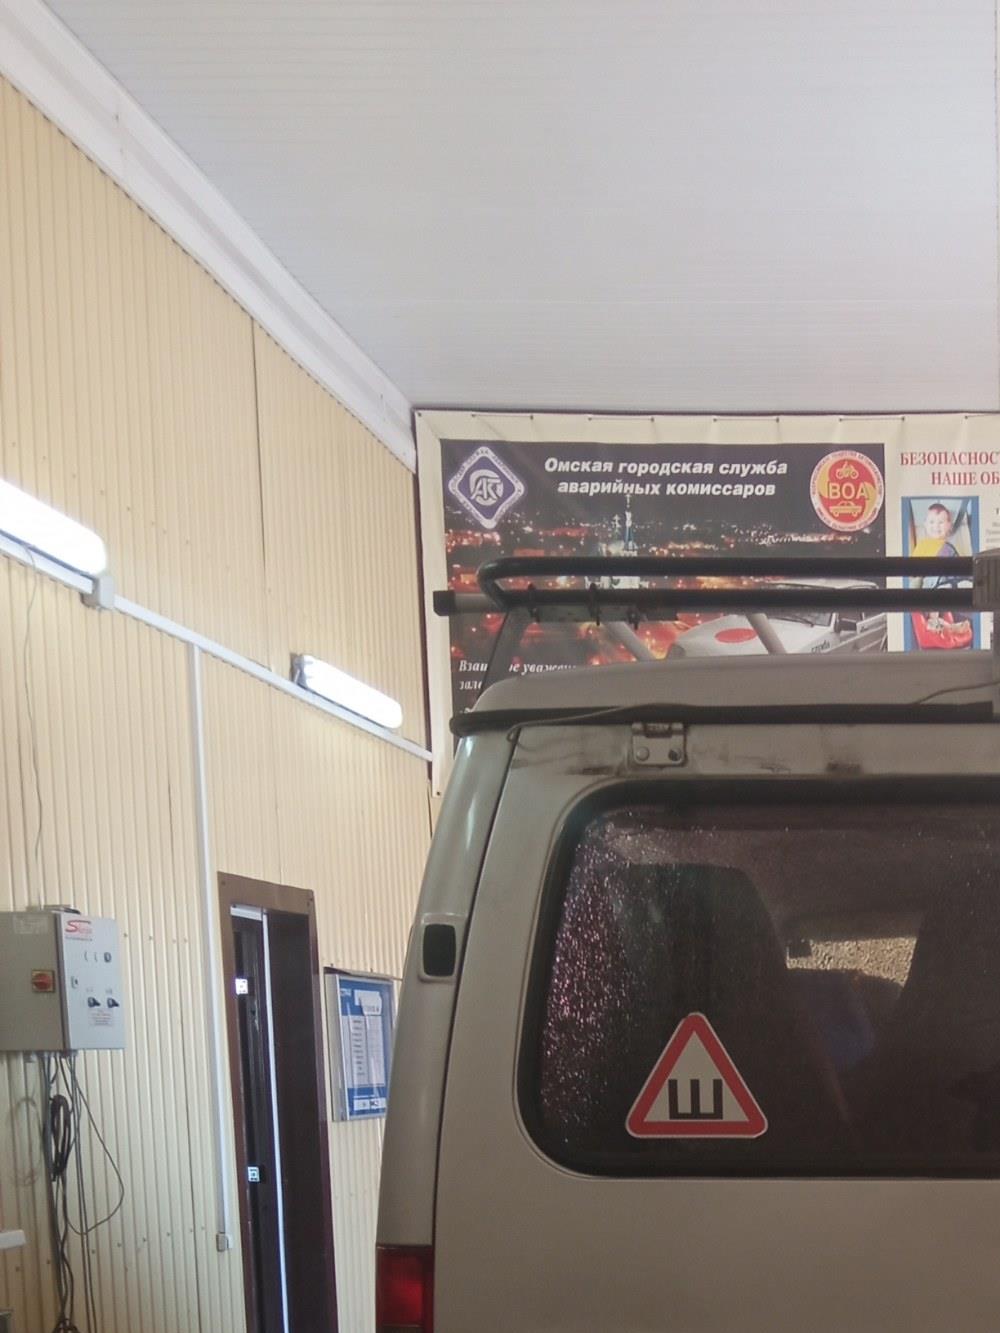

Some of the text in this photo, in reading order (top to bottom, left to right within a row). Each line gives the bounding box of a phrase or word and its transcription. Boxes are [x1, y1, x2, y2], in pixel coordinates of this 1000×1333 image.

[544, 457, 613, 473] Омская
[618, 460, 713, 477] городская
[719, 460, 788, 478] служба
[931, 471, 977, 486] НАШЕ
[557, 479, 776, 499] аварийных комиссаров
[667, 1077, 724, 1120] Ш
